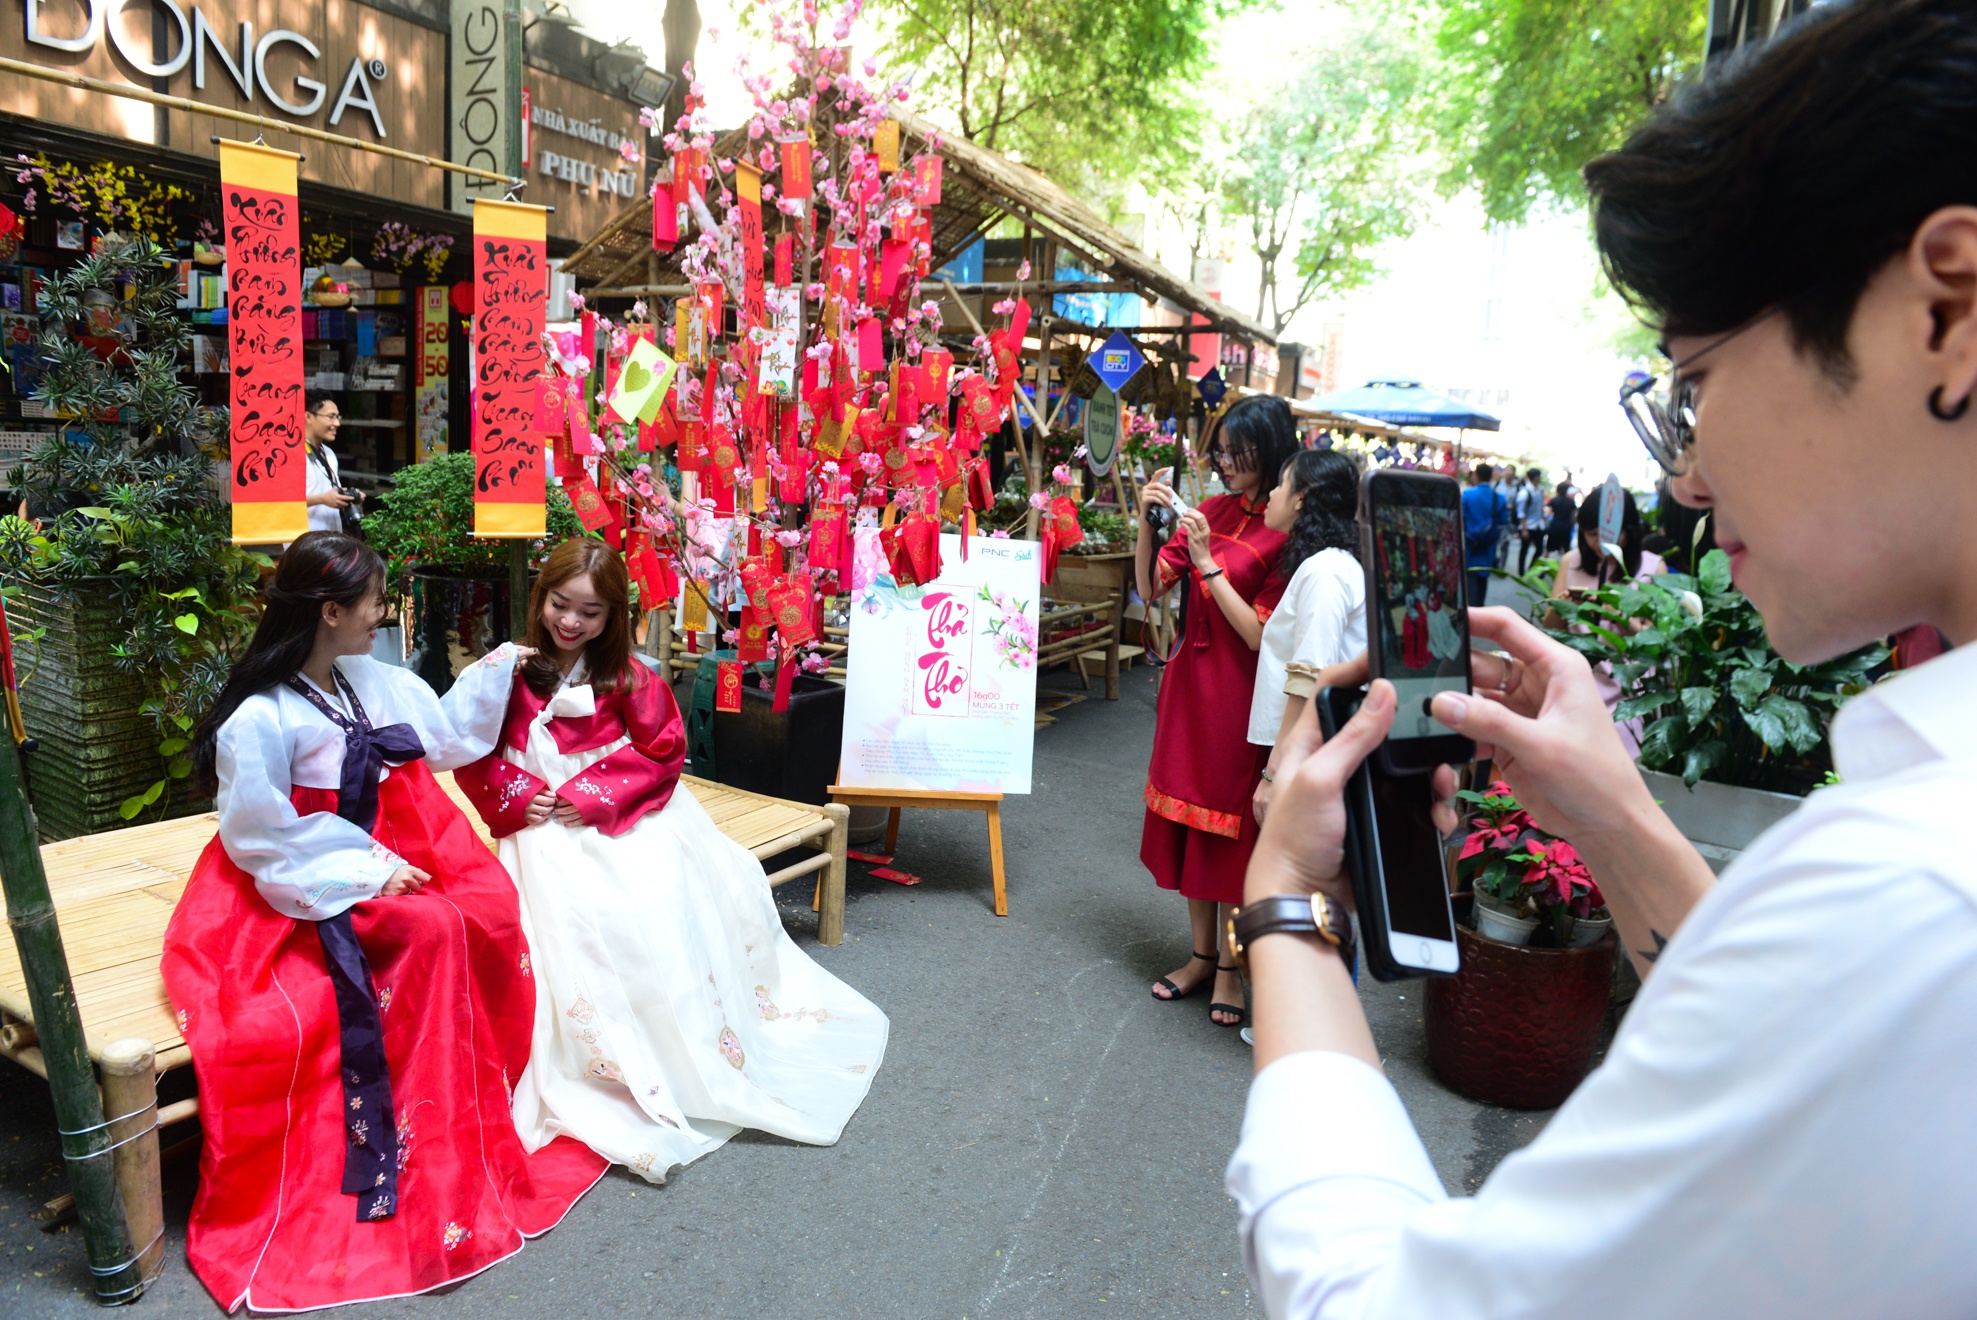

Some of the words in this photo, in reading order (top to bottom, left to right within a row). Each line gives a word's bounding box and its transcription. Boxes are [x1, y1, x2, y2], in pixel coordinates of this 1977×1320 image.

[531, 105, 566, 132] NHÀ
[539, 150, 596, 196] PHỤ
[598, 164, 637, 198] NỮ
[981, 548, 1010, 557] PNC
[921, 592, 968, 649] Thả
[917, 651, 968, 709] Thơ
